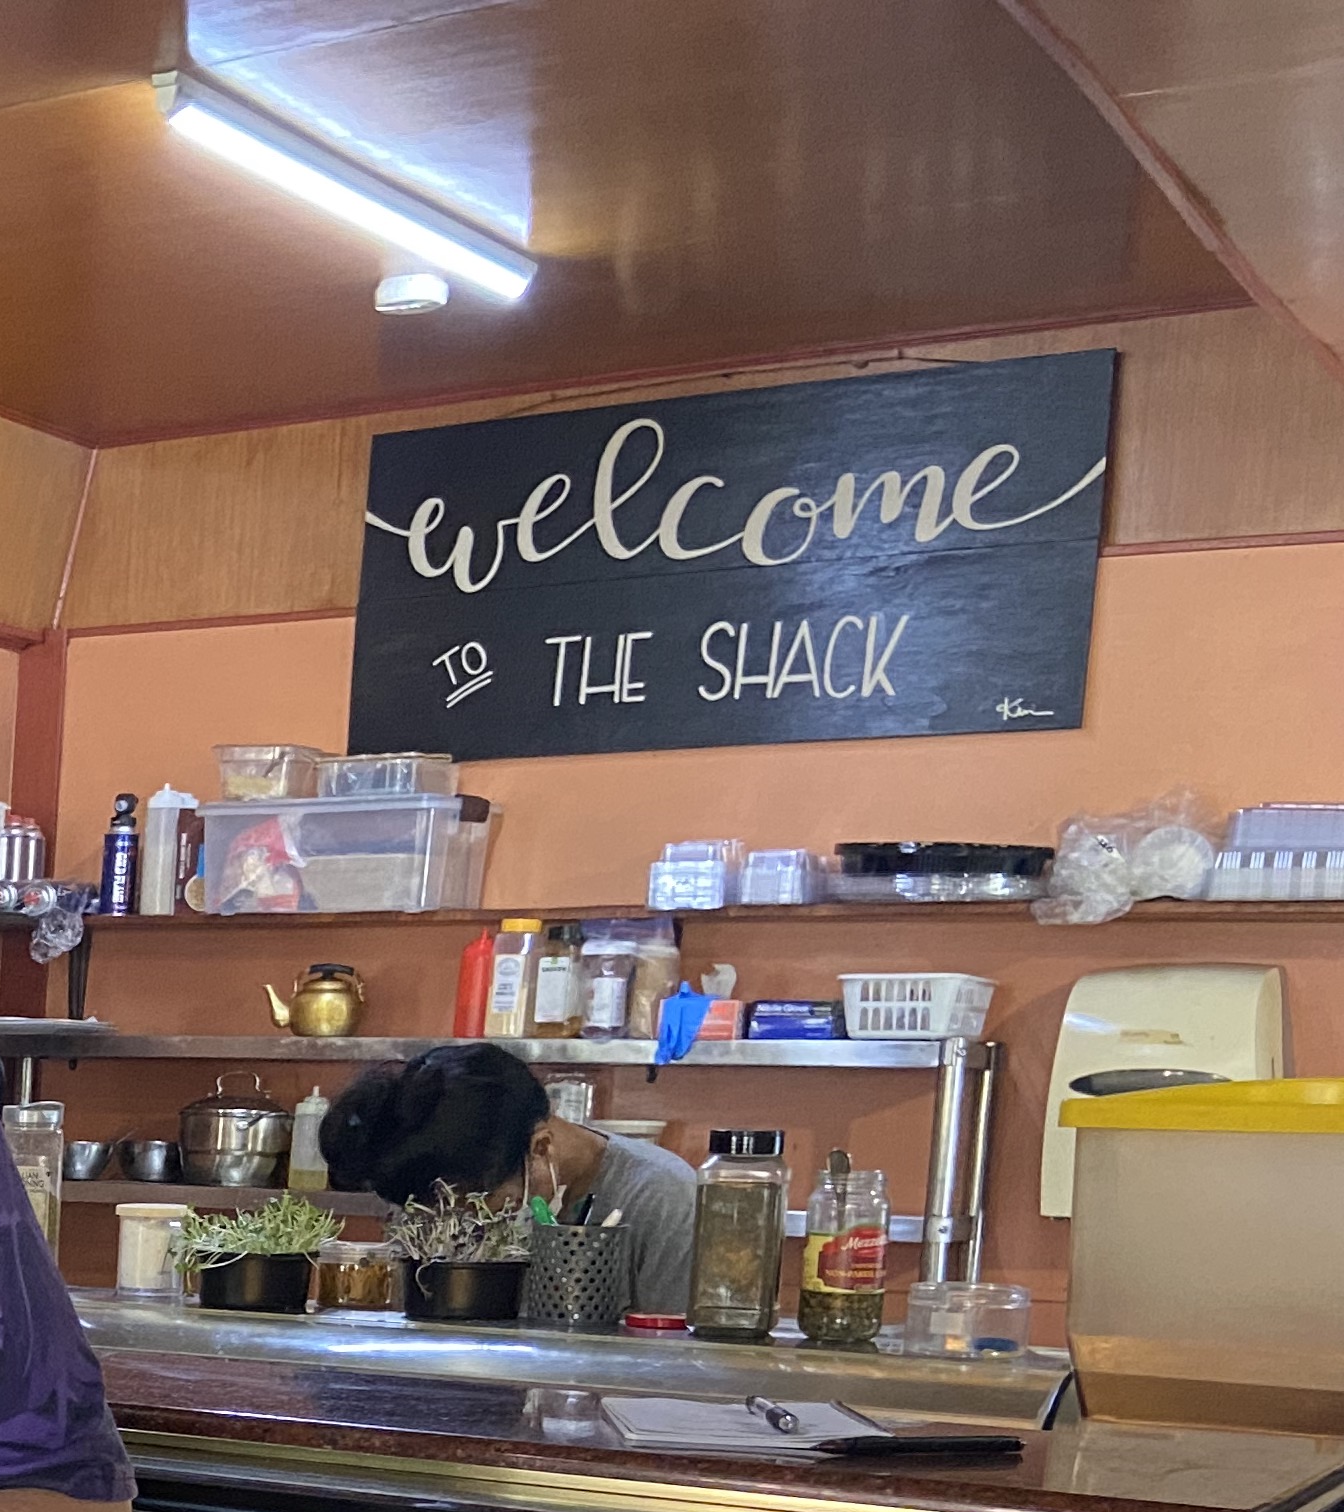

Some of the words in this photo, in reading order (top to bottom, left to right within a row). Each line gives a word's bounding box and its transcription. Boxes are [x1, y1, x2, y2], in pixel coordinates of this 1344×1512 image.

[365, 418, 1108, 594] welcome
[433, 641, 490, 686] TO
[545, 630, 653, 707] THE
[698, 615, 909, 702] SHACK
